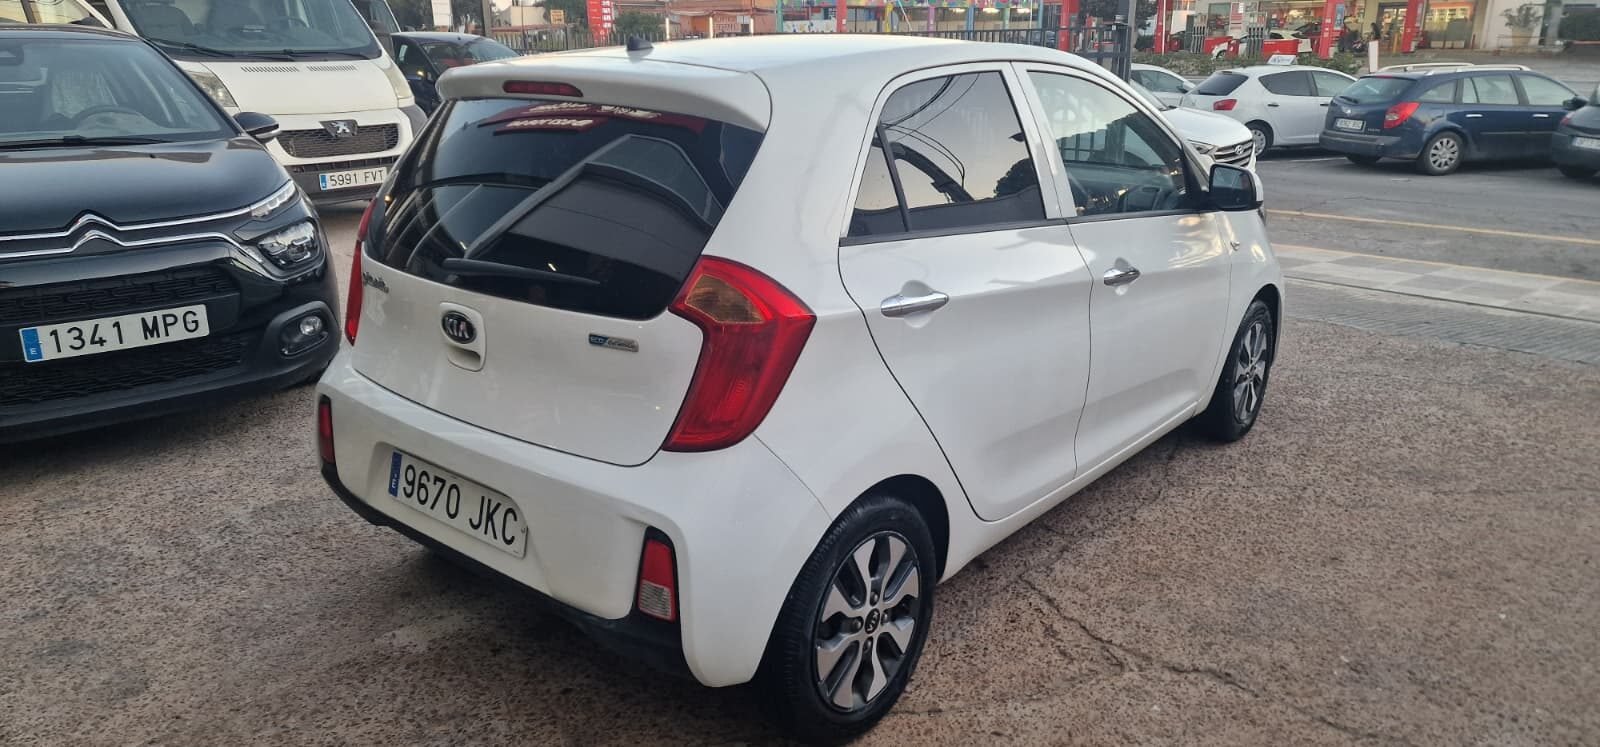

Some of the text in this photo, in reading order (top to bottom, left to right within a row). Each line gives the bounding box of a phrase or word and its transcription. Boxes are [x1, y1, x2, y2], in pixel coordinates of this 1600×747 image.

[329, 169, 384, 187] 5991 FVT
[49, 310, 200, 353] 1341 MPG
[444, 316, 470, 339] KIA
[402, 464, 518, 546] 9670 JKC
